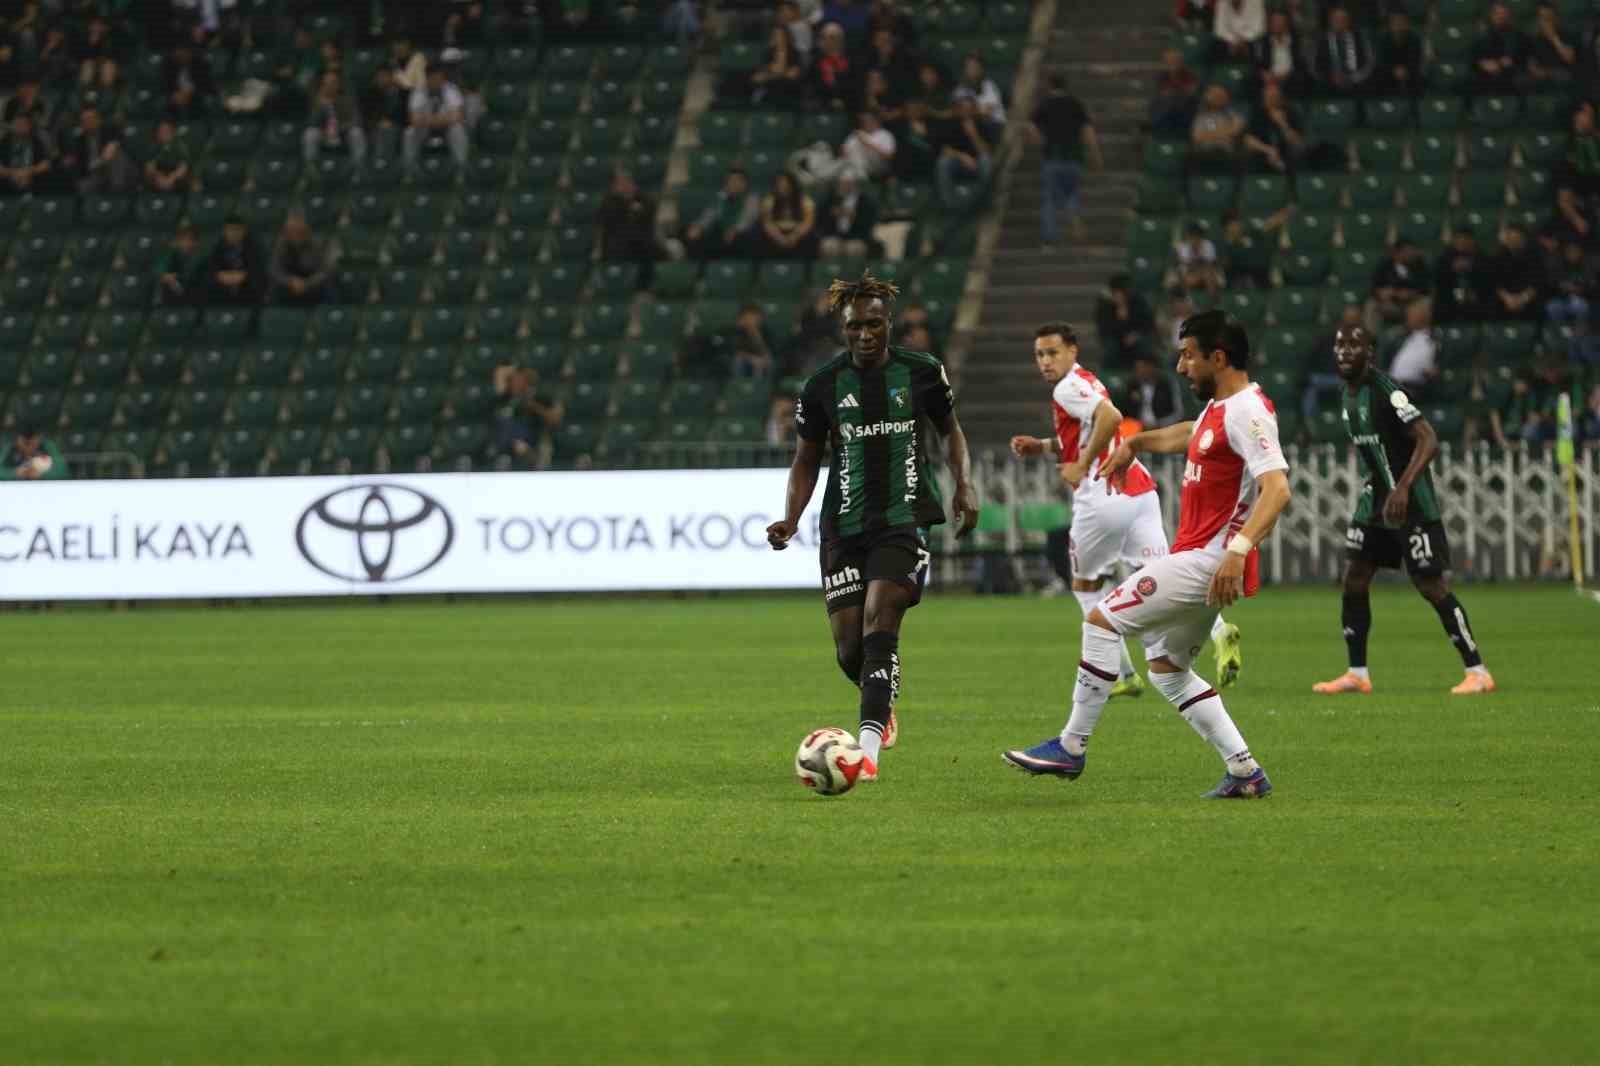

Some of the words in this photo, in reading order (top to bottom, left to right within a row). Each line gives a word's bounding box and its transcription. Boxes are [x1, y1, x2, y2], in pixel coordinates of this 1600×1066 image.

[855, 420, 915, 437] SAFİPORT
[134, 523, 253, 559] KAYA
[477, 515, 654, 552] TOYOTA
[1409, 532, 1433, 560] 21
